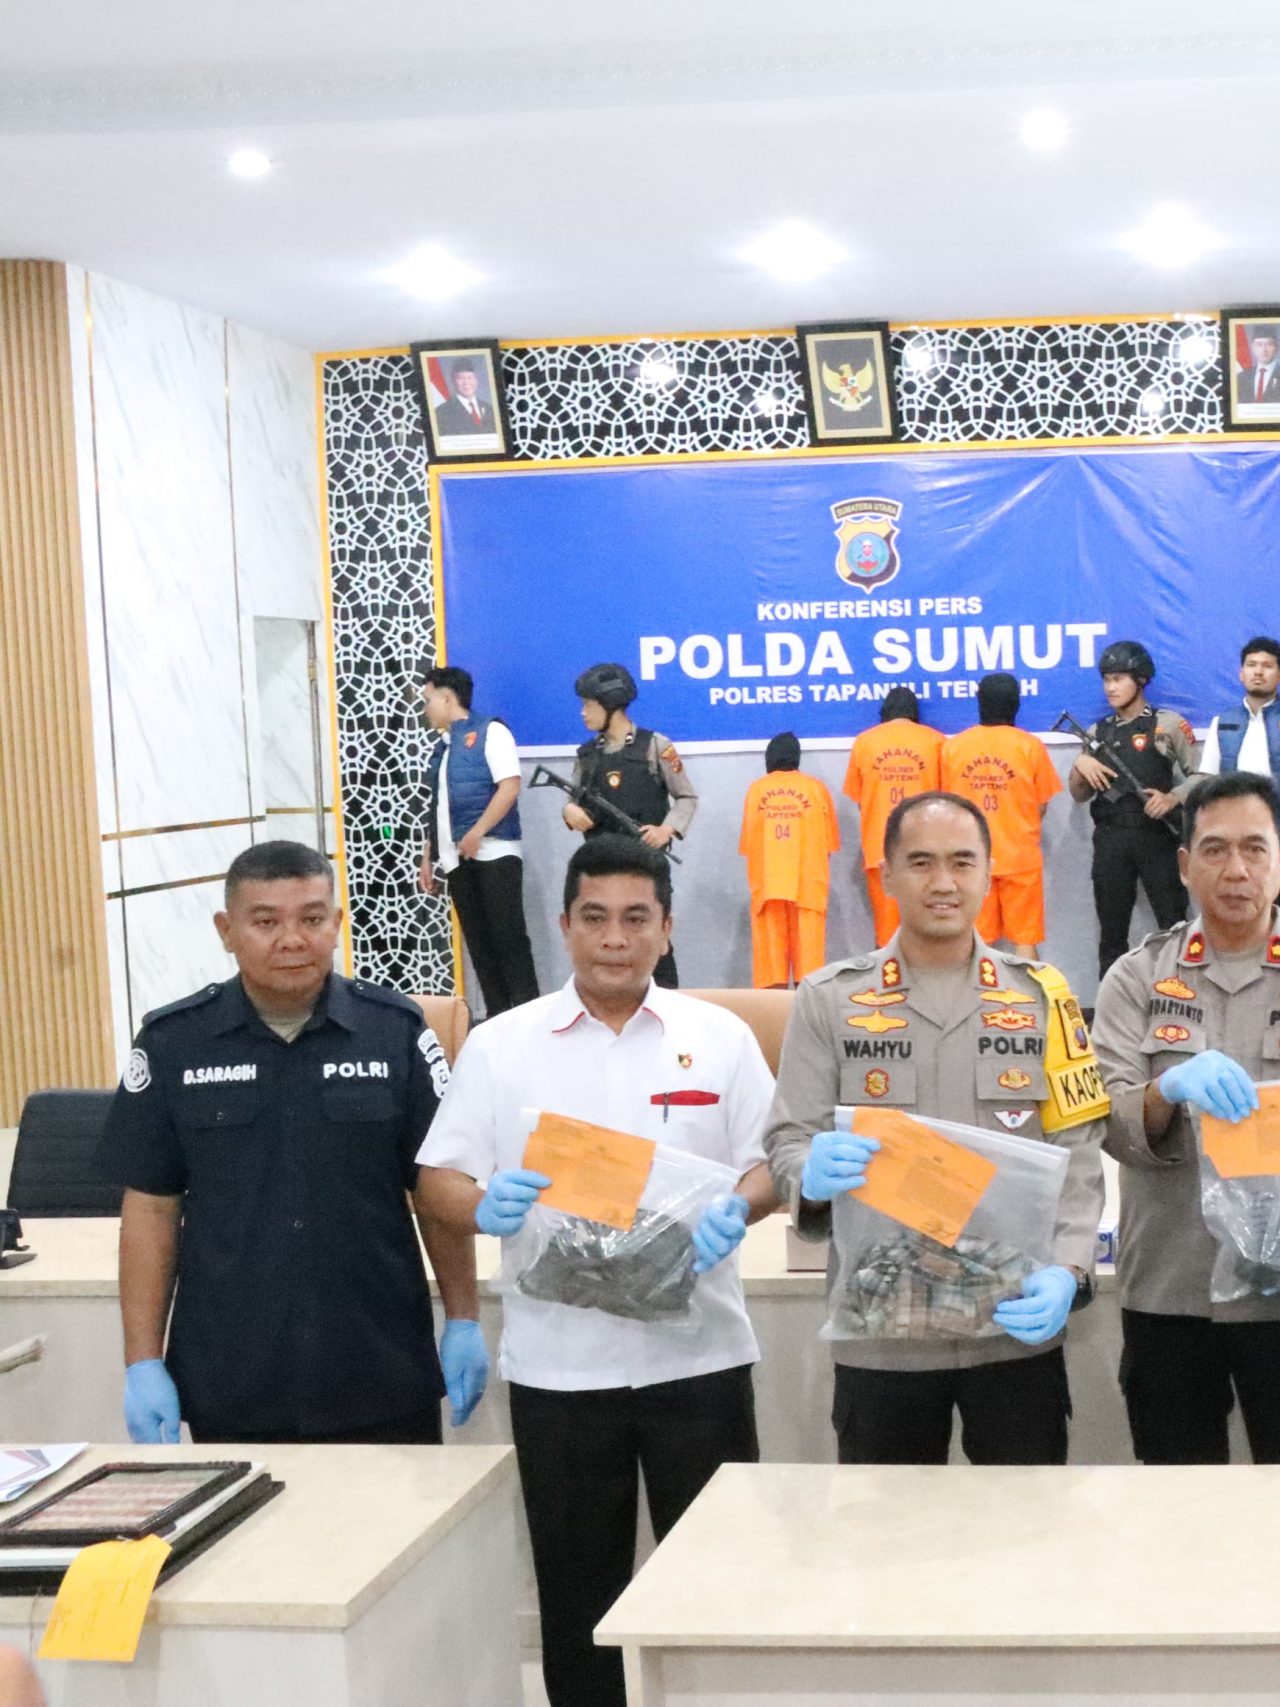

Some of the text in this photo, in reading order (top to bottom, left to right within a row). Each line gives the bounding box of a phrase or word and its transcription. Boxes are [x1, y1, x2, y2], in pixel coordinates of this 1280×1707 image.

[757, 597, 983, 621] KONFERENSI PERS
[640, 623, 1107, 680] POLDA SUMUT
[709, 679, 1039, 705] POLRES TAPANLI TENH
[872, 748, 927, 771] TAHANAN
[961, 755, 1017, 781] TAHANAN
[758, 788, 812, 811] TAHANAN
[890, 787, 905, 805] 01
[983, 795, 999, 812] 03
[775, 823, 791, 840] 04
[843, 1039, 913, 1059] WAHYU
[978, 1036, 1043, 1056] POLRI
[183, 1064, 257, 1085] D.SARAGIH
[322, 1061, 389, 1079] POLRI
